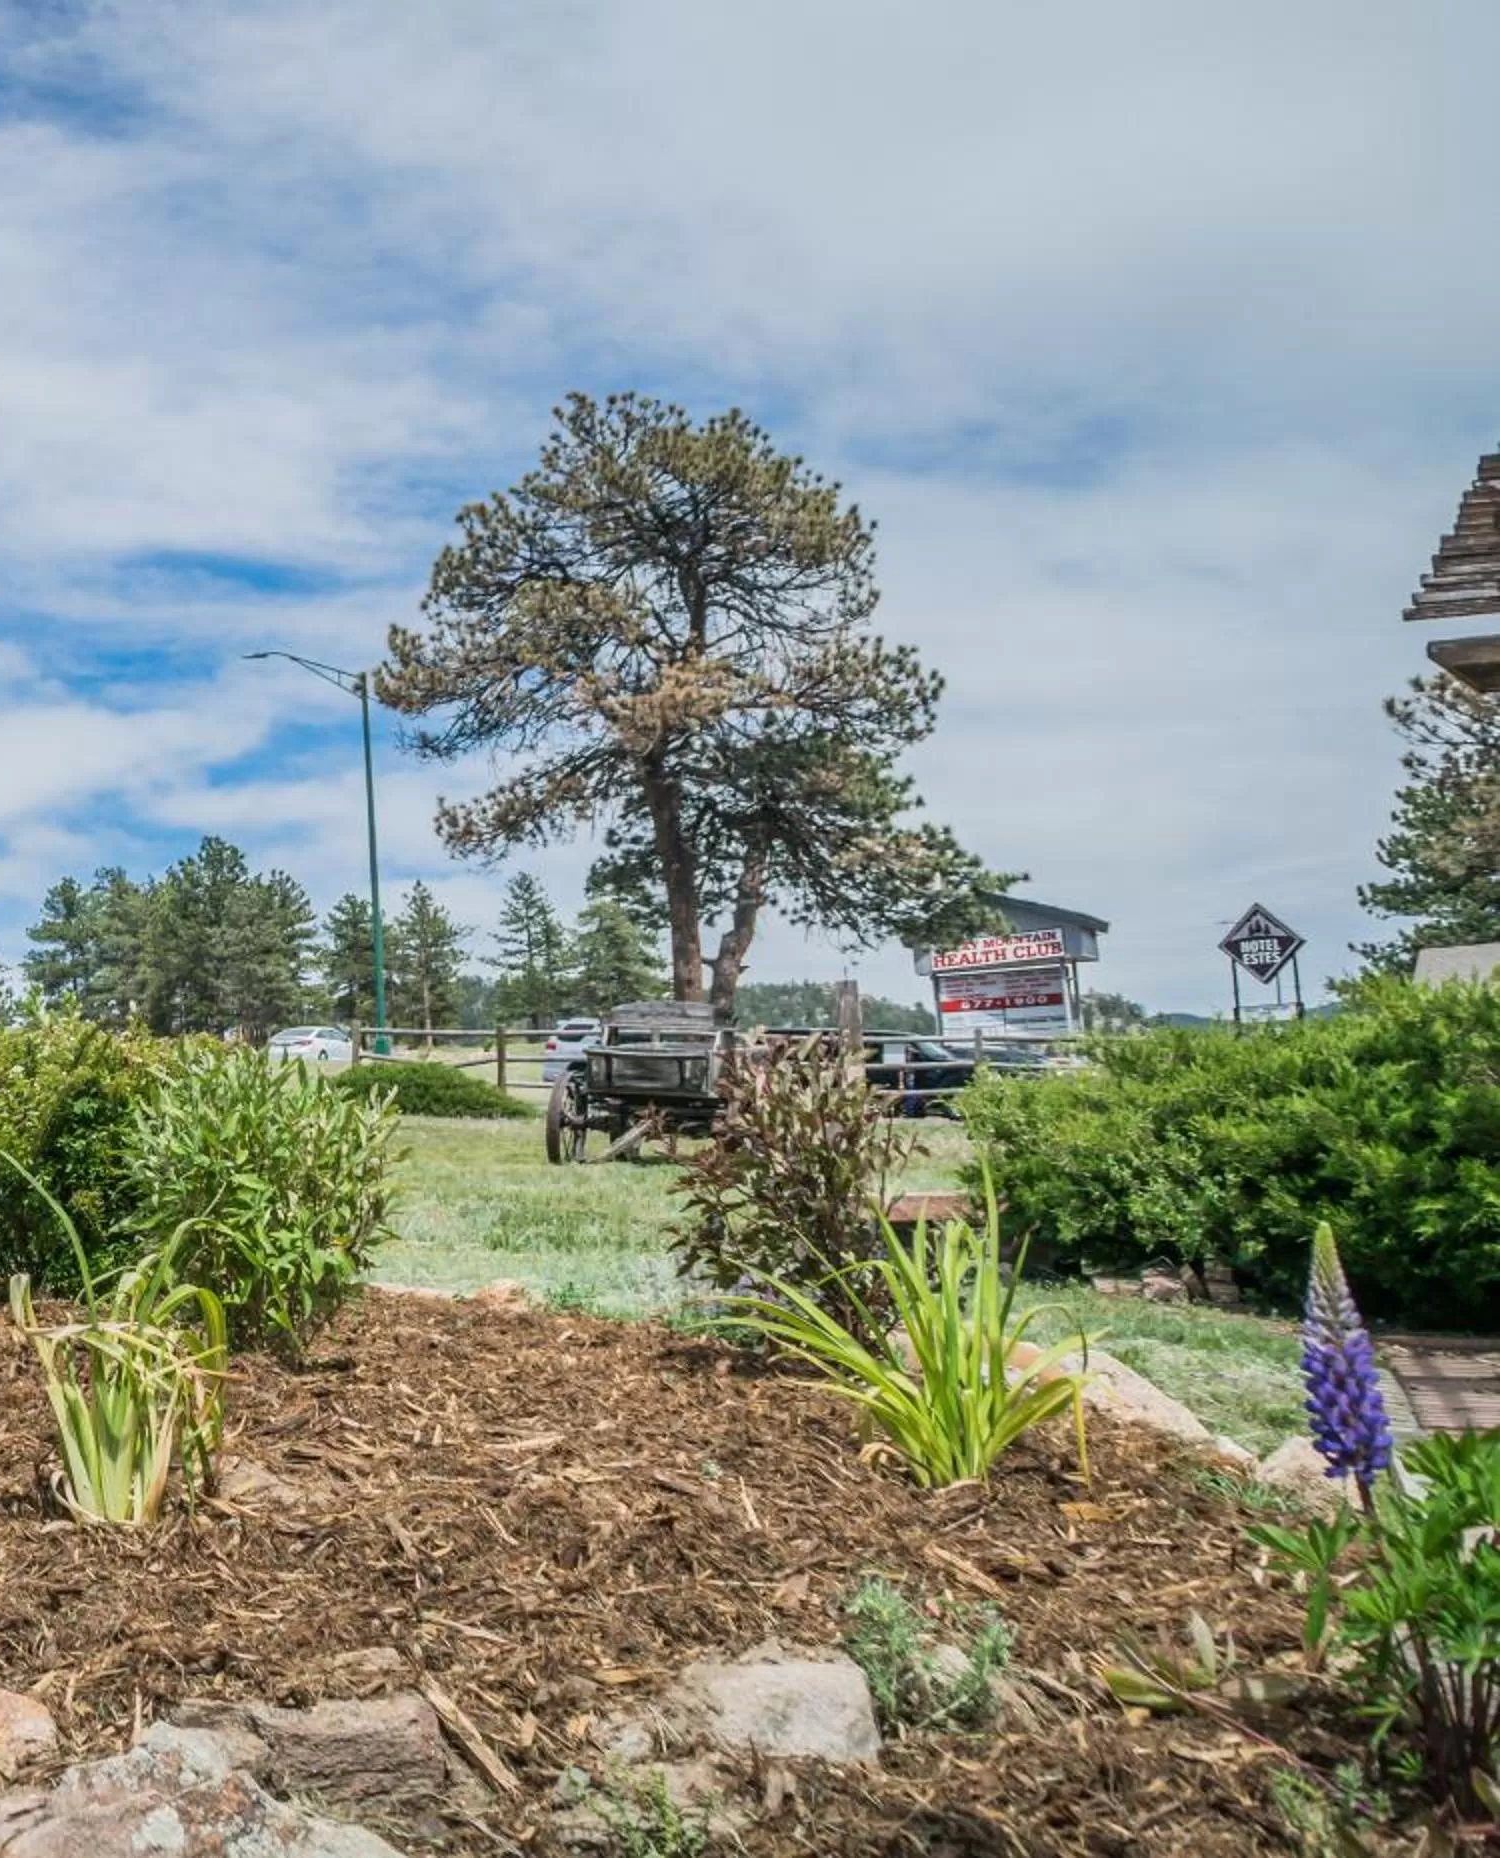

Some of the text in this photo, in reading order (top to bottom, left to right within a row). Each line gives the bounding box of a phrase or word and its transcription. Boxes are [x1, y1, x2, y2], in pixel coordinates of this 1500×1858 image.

[1241, 939, 1281, 953] HOTEL
[934, 942, 1062, 968] HEALTH CLUB
[1243, 952, 1280, 965] ESTES
